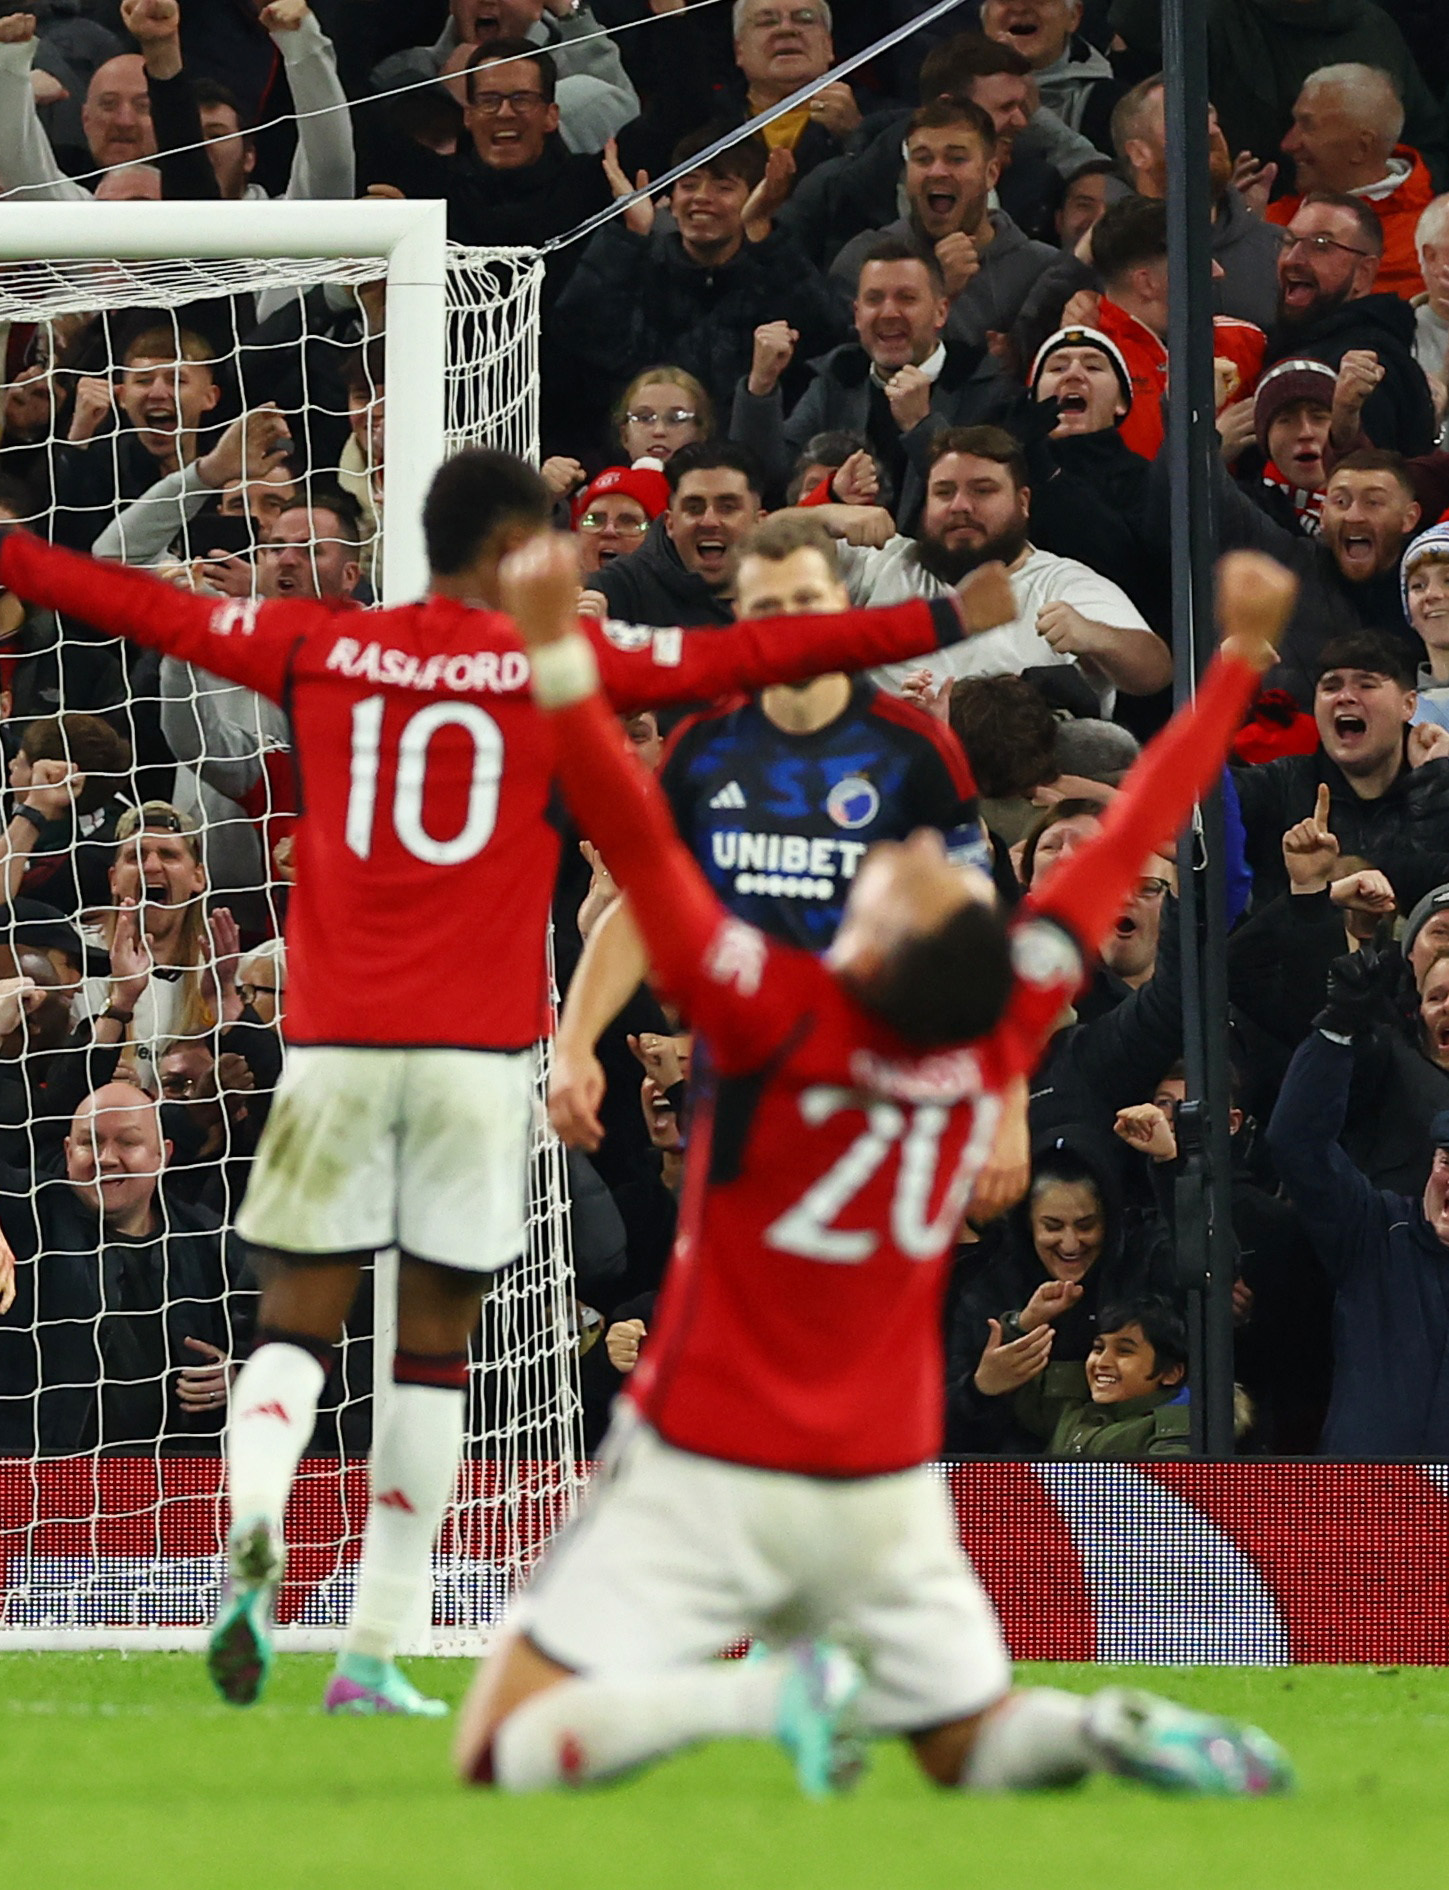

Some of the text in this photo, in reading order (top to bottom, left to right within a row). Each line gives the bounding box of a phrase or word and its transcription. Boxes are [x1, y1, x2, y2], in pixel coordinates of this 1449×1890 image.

[345, 695, 505, 867] 10
[712, 831, 868, 880] UNIBET
[764, 1083, 1002, 1265] 20
